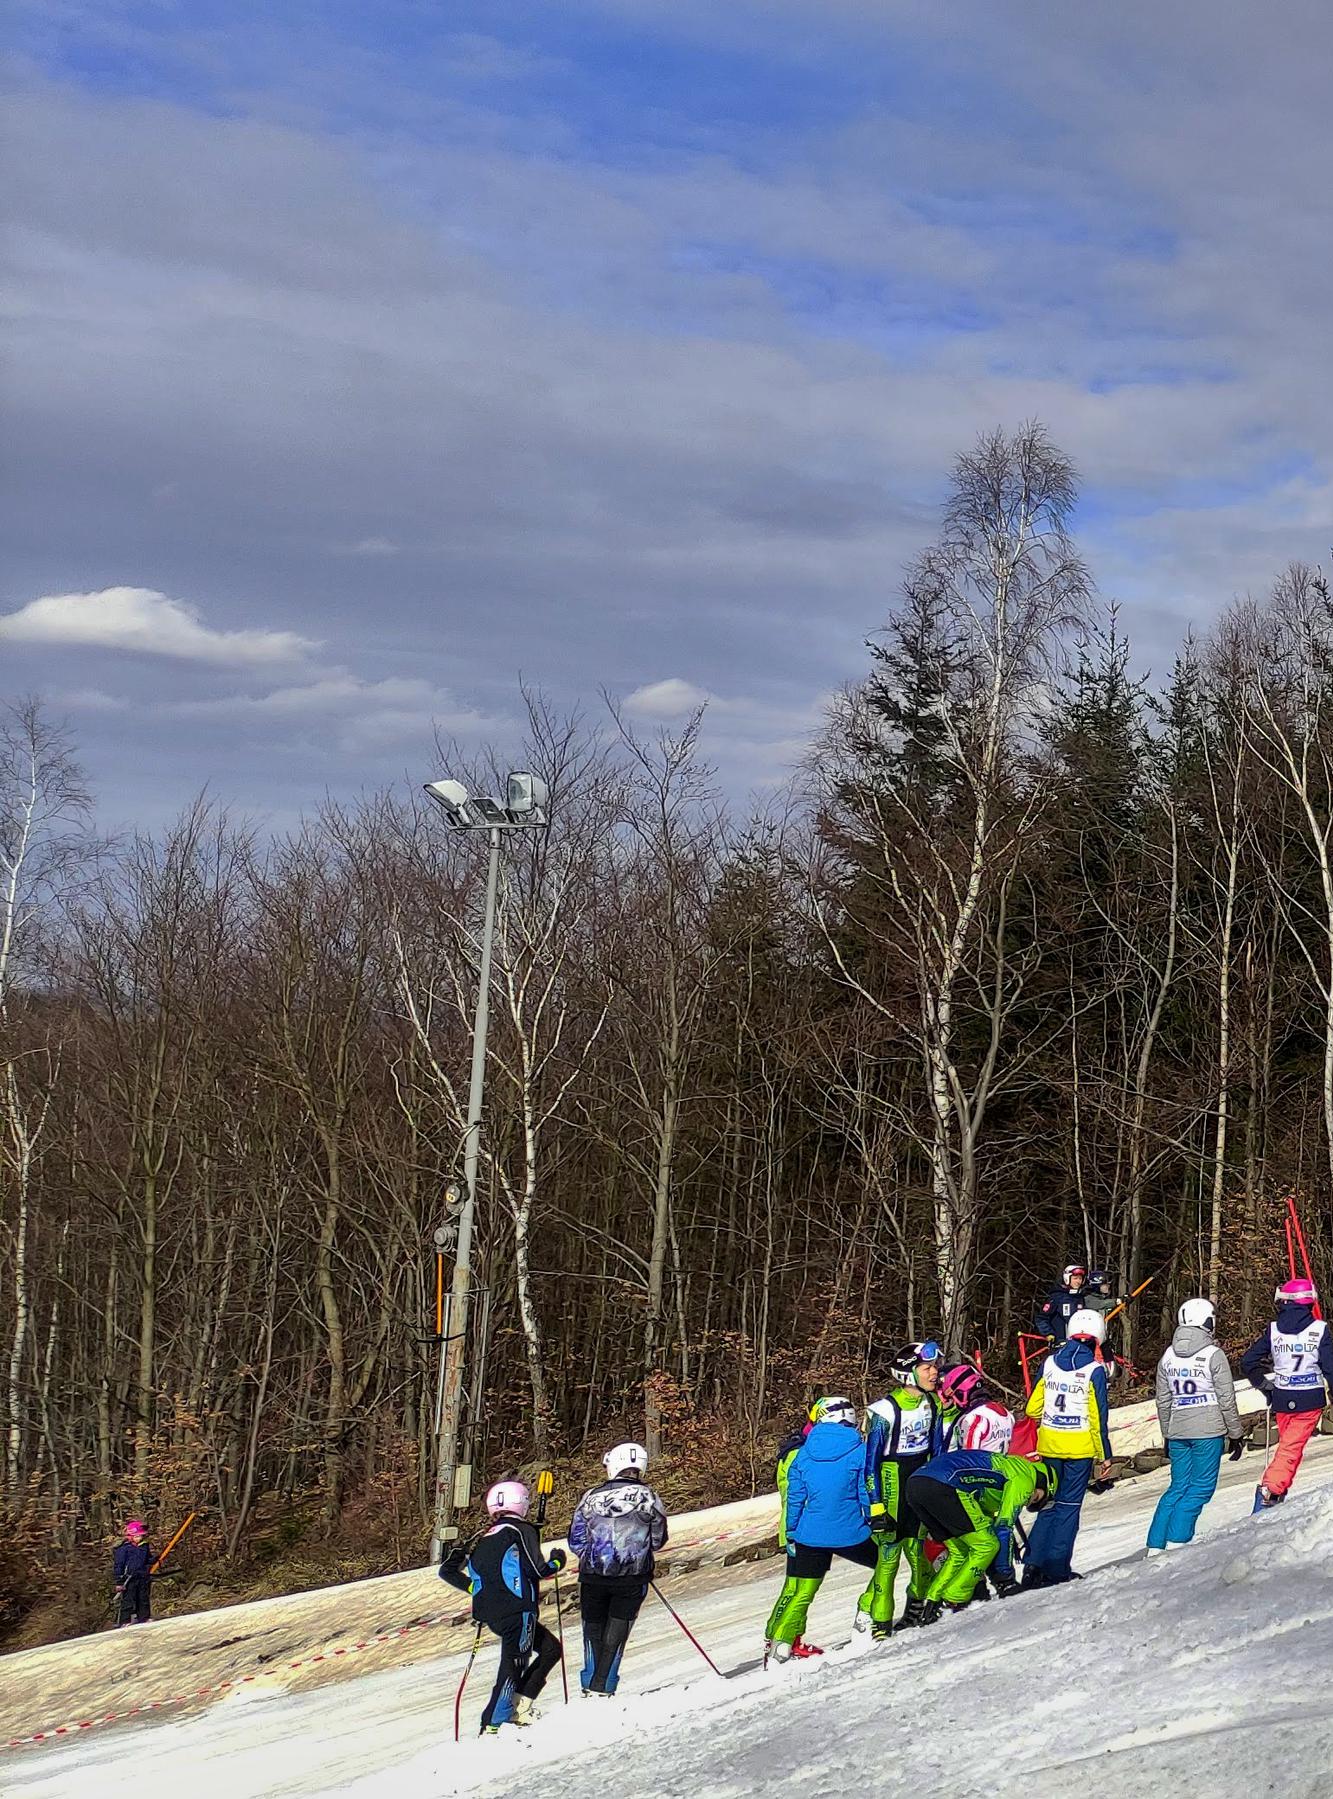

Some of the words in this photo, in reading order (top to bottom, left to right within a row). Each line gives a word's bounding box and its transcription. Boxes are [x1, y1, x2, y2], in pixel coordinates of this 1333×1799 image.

[1273, 1342, 1318, 1353] MINOLTA
[1291, 1354, 1305, 1373] 7
[1165, 1367, 1207, 1379] MINOLTA
[1043, 1380, 1085, 1395] MINOLTA
[1172, 1379, 1197, 1396] 10
[1054, 1393, 1067, 1413] 4
